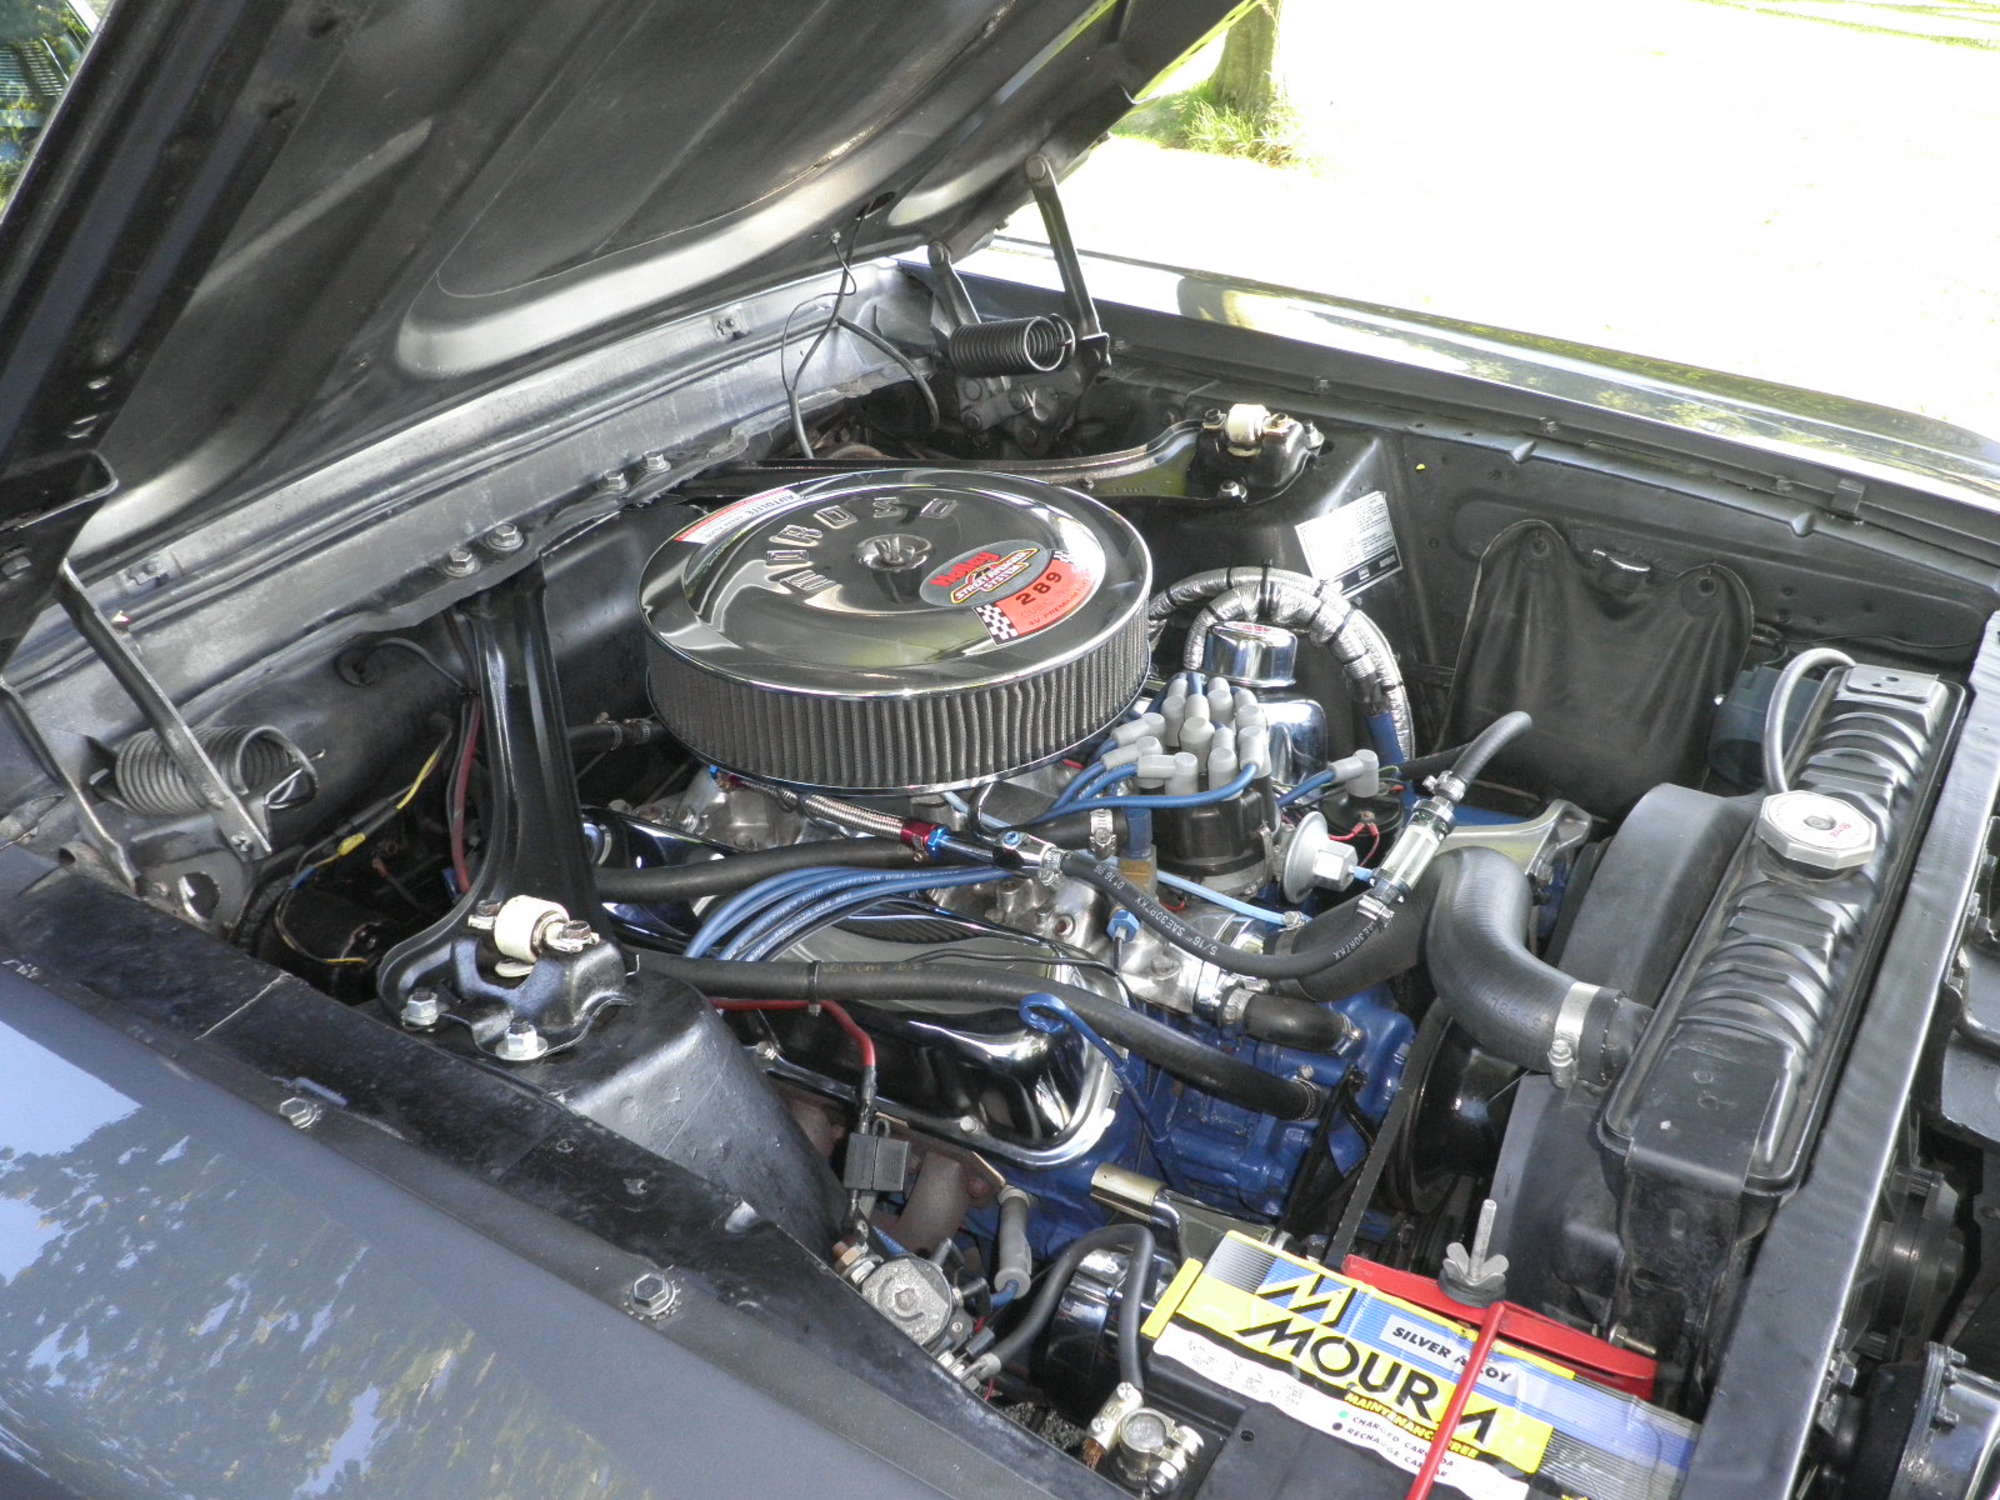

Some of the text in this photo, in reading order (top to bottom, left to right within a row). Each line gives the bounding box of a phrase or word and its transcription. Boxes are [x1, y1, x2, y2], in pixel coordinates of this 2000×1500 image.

[929, 551, 1001, 588] Holley
[1015, 571, 1062, 606] 289
[1392, 1327, 1514, 1384] SILVER AOY
[1235, 1317, 1499, 1443] MOURA
